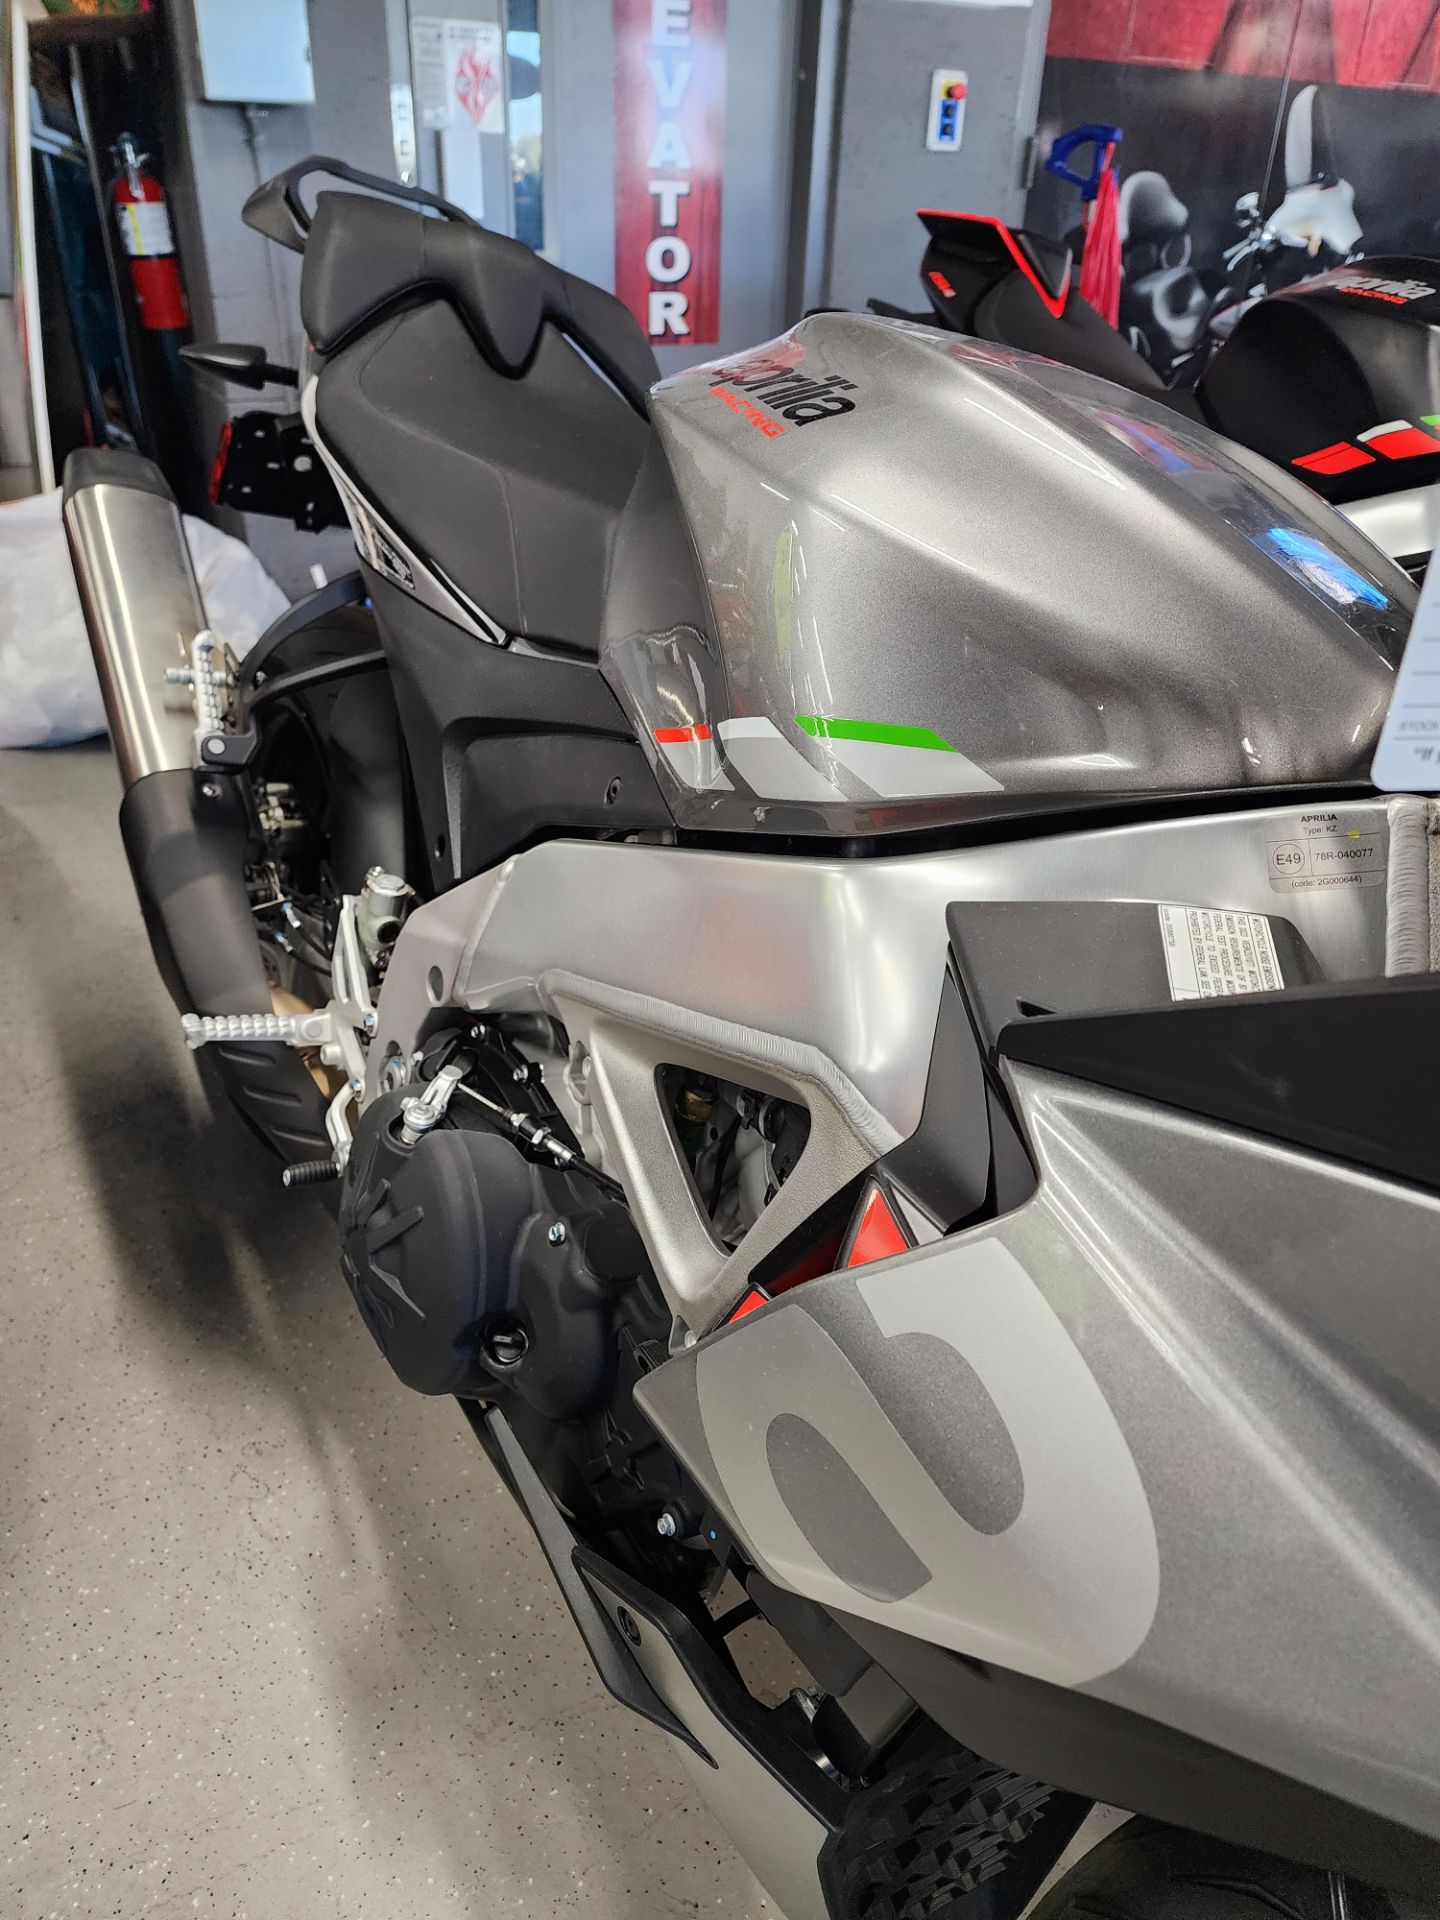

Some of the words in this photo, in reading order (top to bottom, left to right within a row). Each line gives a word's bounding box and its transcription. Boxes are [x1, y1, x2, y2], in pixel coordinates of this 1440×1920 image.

[708, 386, 786, 439] RACING
[1301, 814, 1338, 823] APRILIA
[1303, 826, 1324, 836] Type:
[1326, 825, 1338, 833] KZ
[1276, 853, 1301, 866] E49
[1315, 848, 1374, 861] 78R-040077
